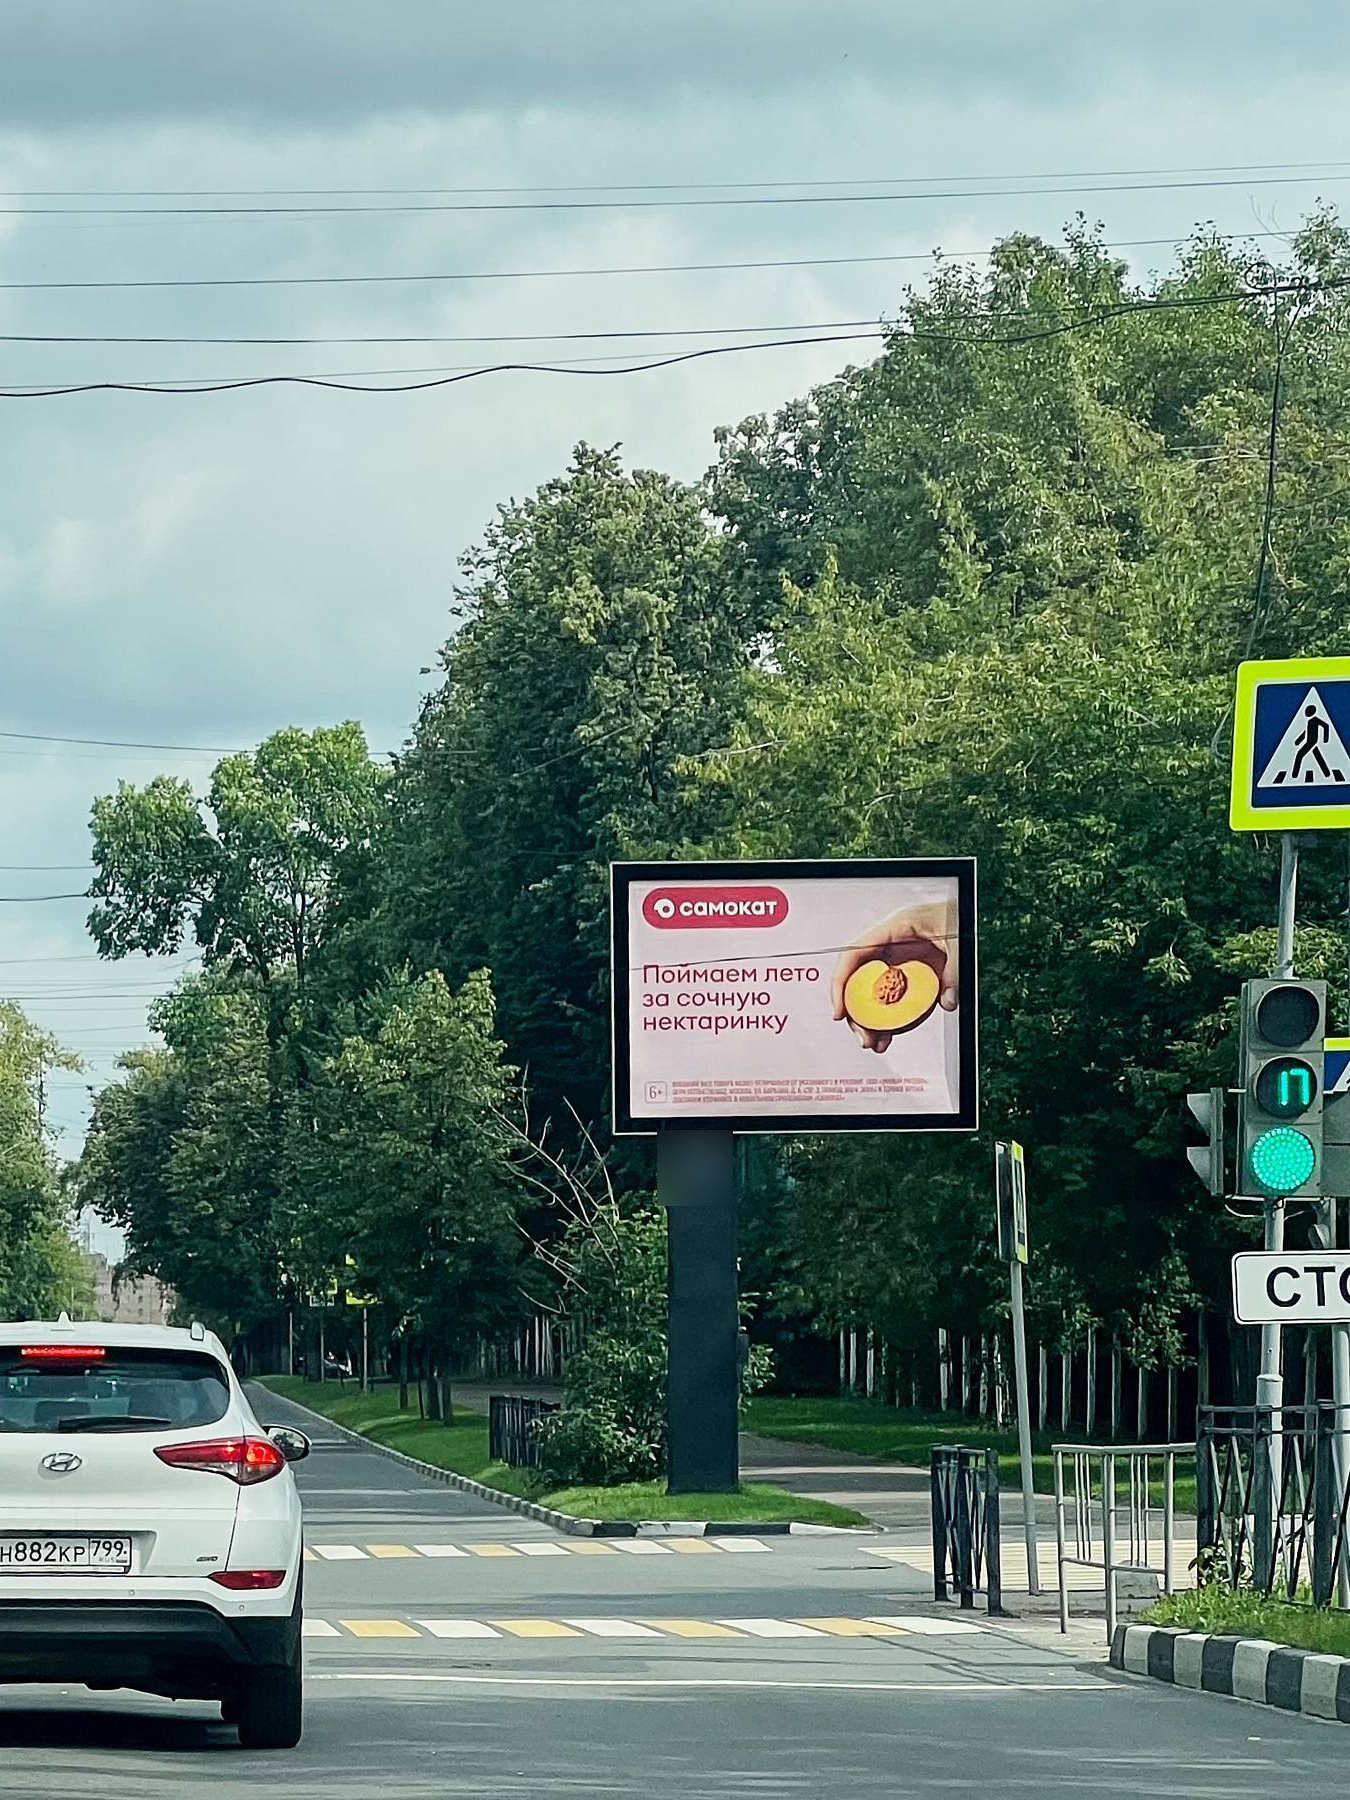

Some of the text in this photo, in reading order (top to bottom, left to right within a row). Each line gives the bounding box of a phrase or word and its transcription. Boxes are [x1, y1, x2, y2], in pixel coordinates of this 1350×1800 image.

[679, 900, 778, 917] самокат
[643, 964, 820, 984] Поймаем лето
[642, 990, 771, 1012] за сочную
[643, 1014, 789, 1035] нектаринку
[90, 1540, 124, 1557] 799
